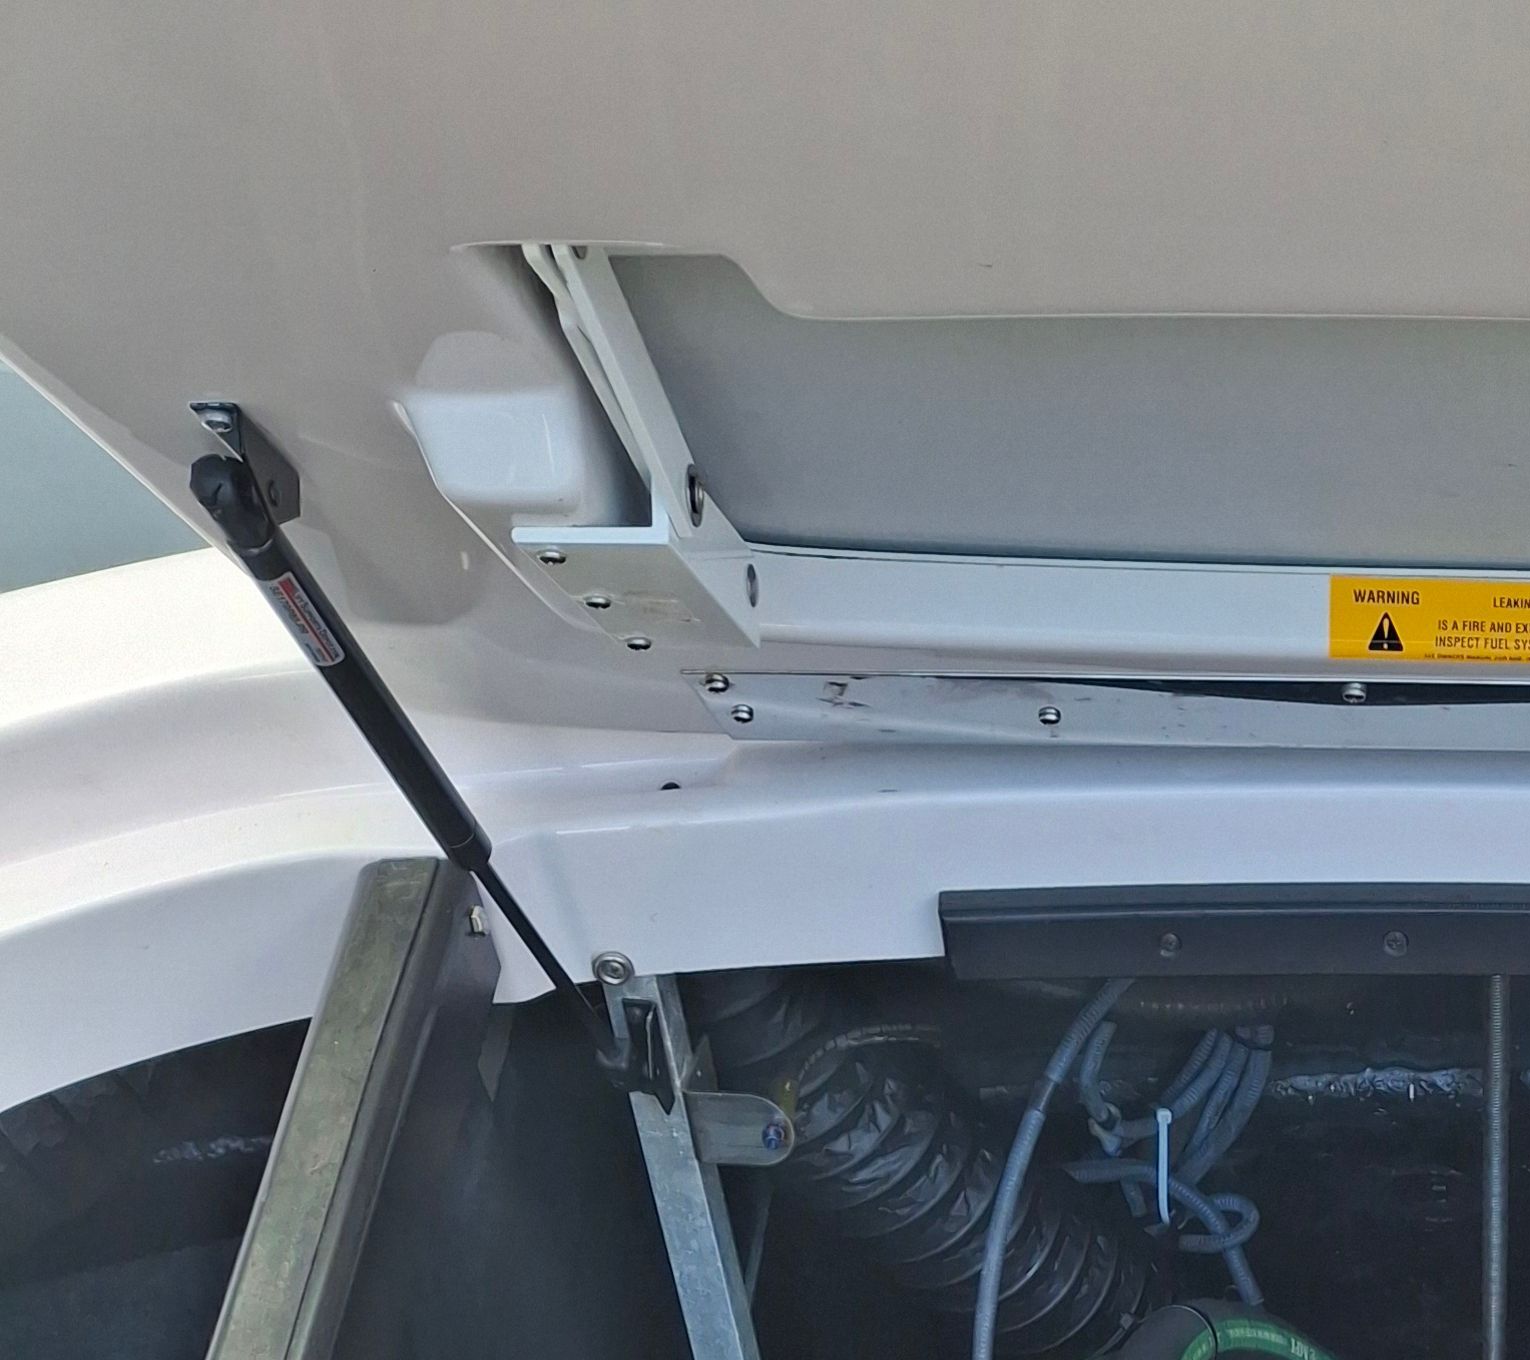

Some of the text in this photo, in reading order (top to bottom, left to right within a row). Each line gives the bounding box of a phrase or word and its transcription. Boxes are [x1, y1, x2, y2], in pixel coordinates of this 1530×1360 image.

[1353, 589, 1420, 605] WARNING
[1438, 619, 1448, 631] IS
[1451, 620, 1458, 631] A
[1462, 620, 1486, 632] FIRE
[1489, 622, 1512, 633] AND
[1435, 636, 1480, 649] INSPECT
[1484, 638, 1510, 650] FUEL
